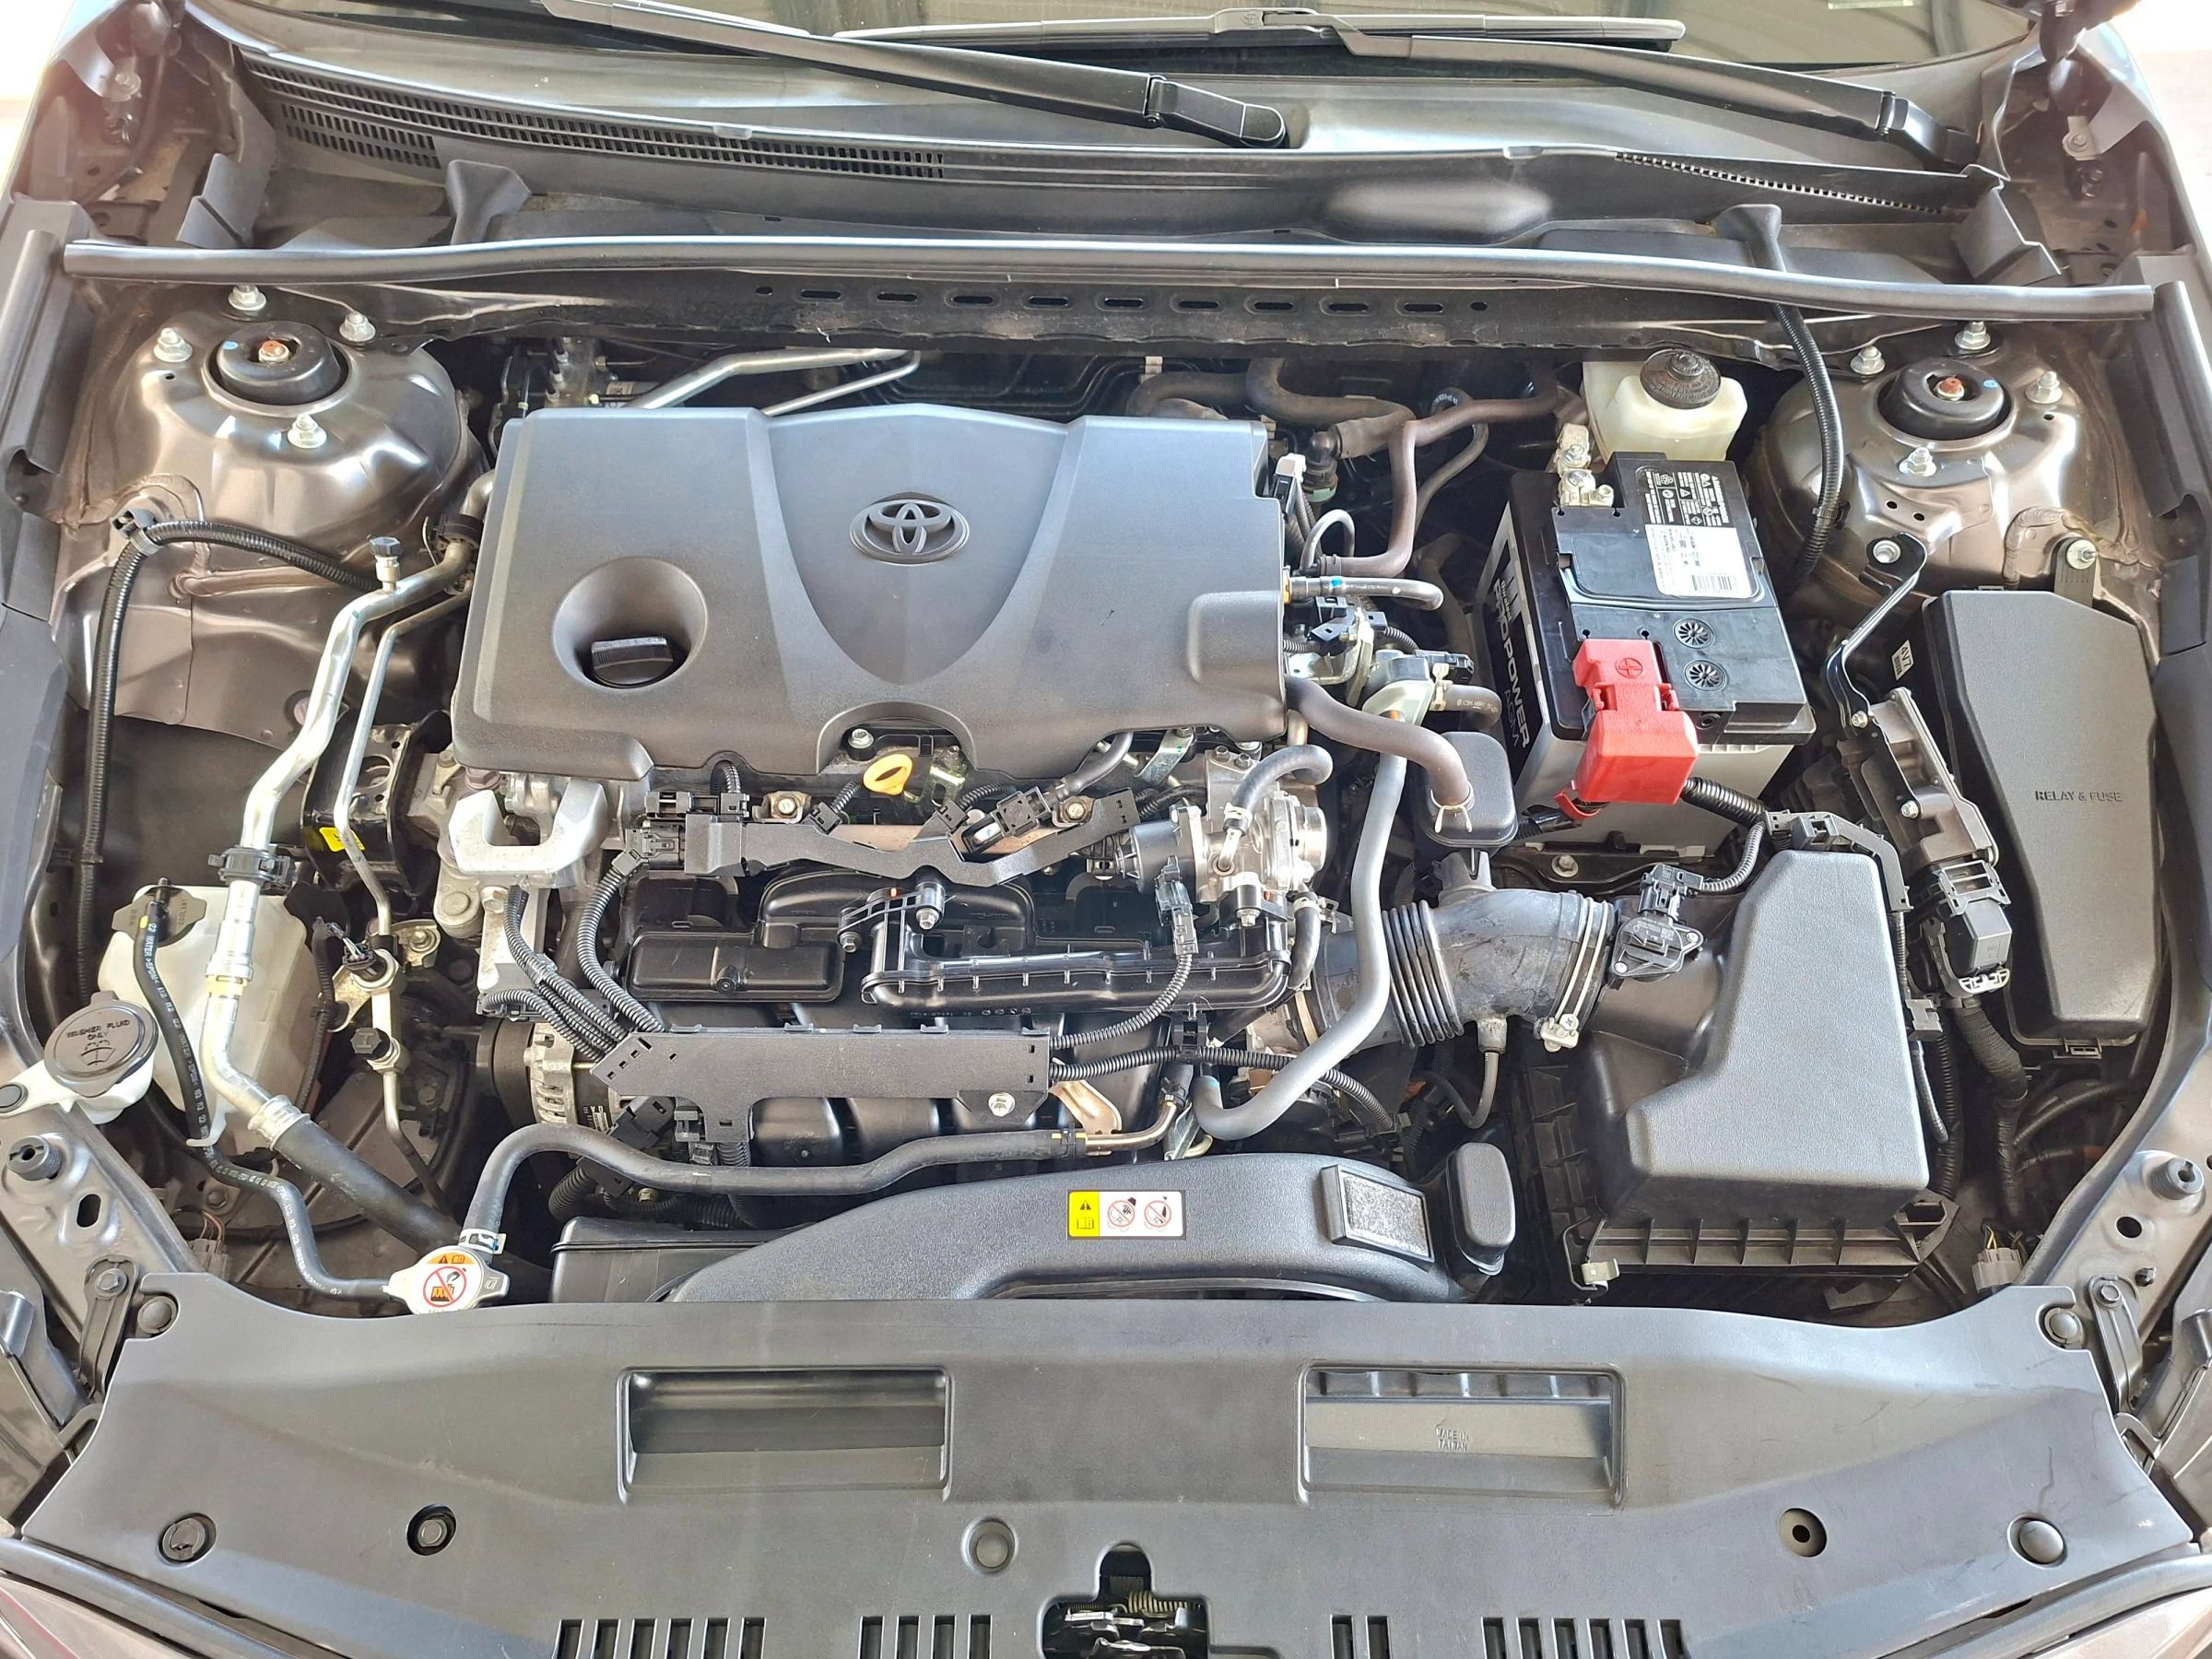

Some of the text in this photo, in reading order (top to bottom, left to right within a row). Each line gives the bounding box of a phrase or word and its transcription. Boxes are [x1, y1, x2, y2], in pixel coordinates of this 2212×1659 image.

[1493, 578, 1530, 748] PROPOWER
[1504, 688, 1520, 747] AGM
[2034, 790, 2124, 803] RELAY & FUSE
[143, 935, 156, 958] WATER
[106, 1019, 131, 1030] FLUID
[87, 1032, 110, 1041] ONLY
[1436, 1428, 1468, 1442] MADE IN
[1438, 1439, 1467, 1453] TAIWAN
